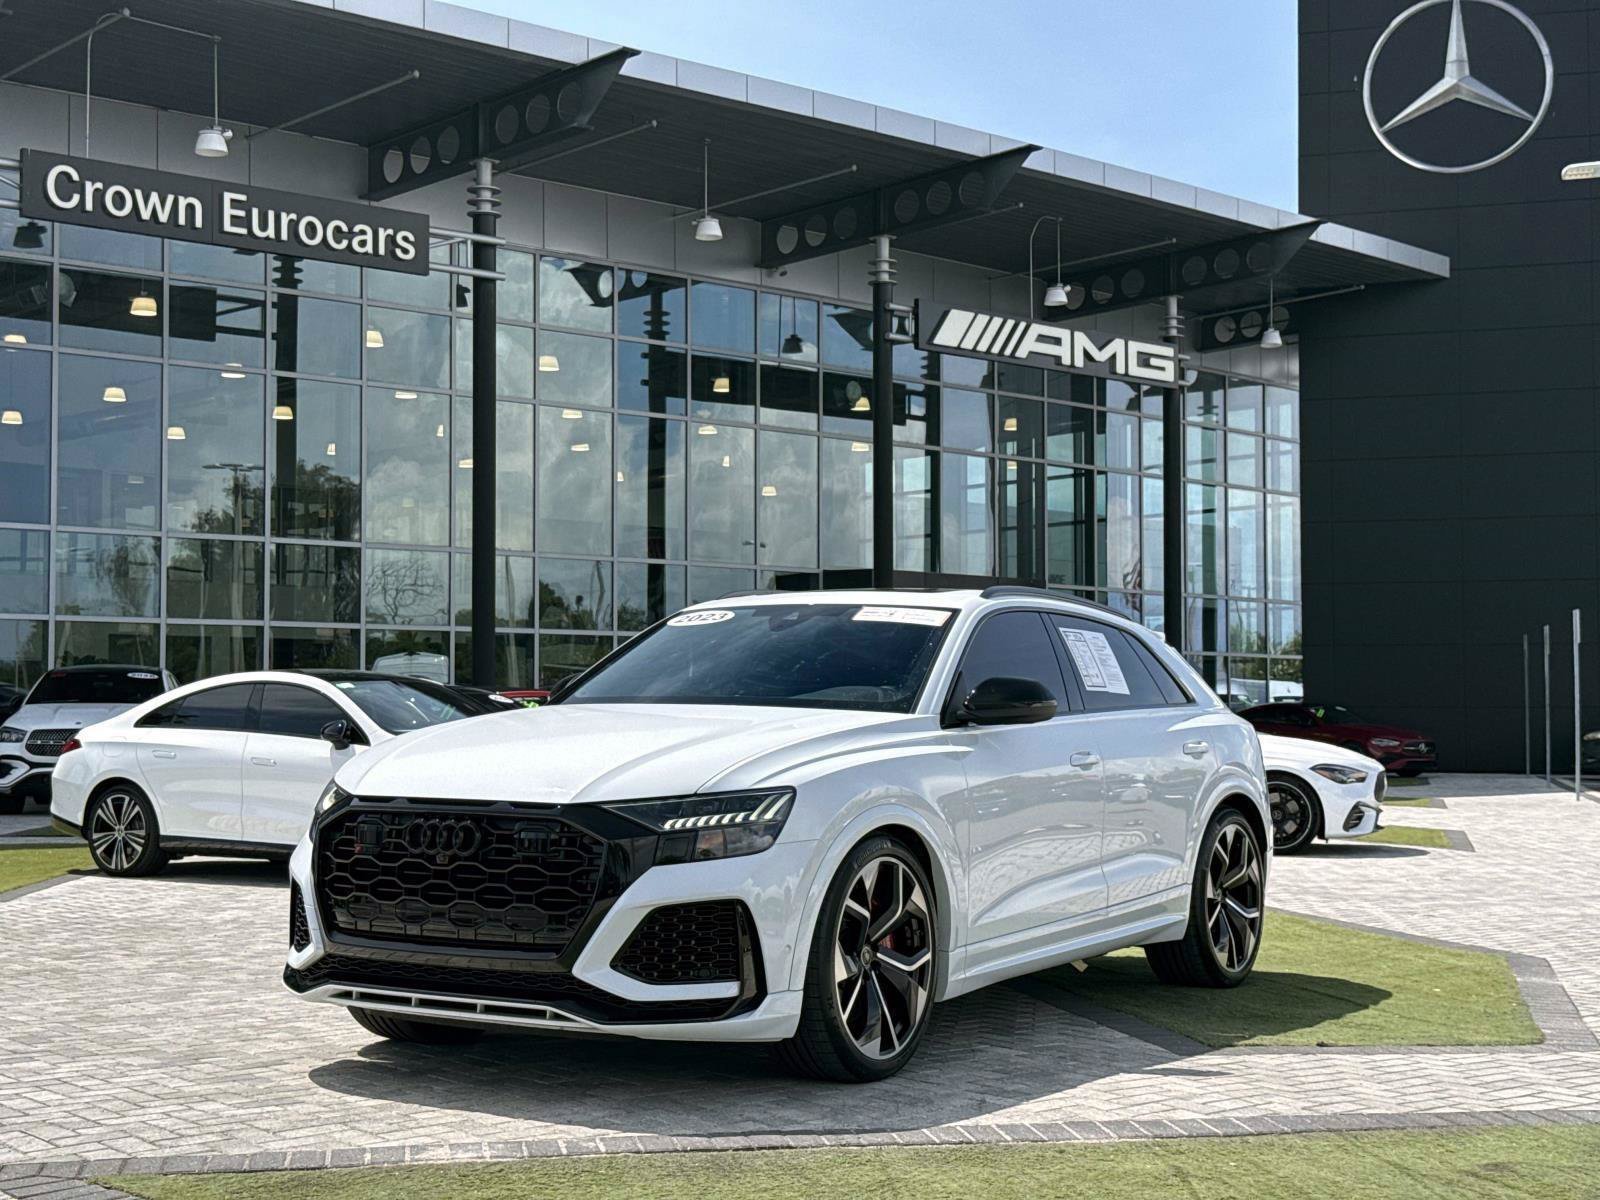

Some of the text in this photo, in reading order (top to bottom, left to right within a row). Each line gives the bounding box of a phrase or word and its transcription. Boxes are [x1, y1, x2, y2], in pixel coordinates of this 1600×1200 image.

[46, 164, 416, 261] Crown Eurocars
[1014, 322, 1175, 383] AMG
[674, 612, 729, 624] 2023
